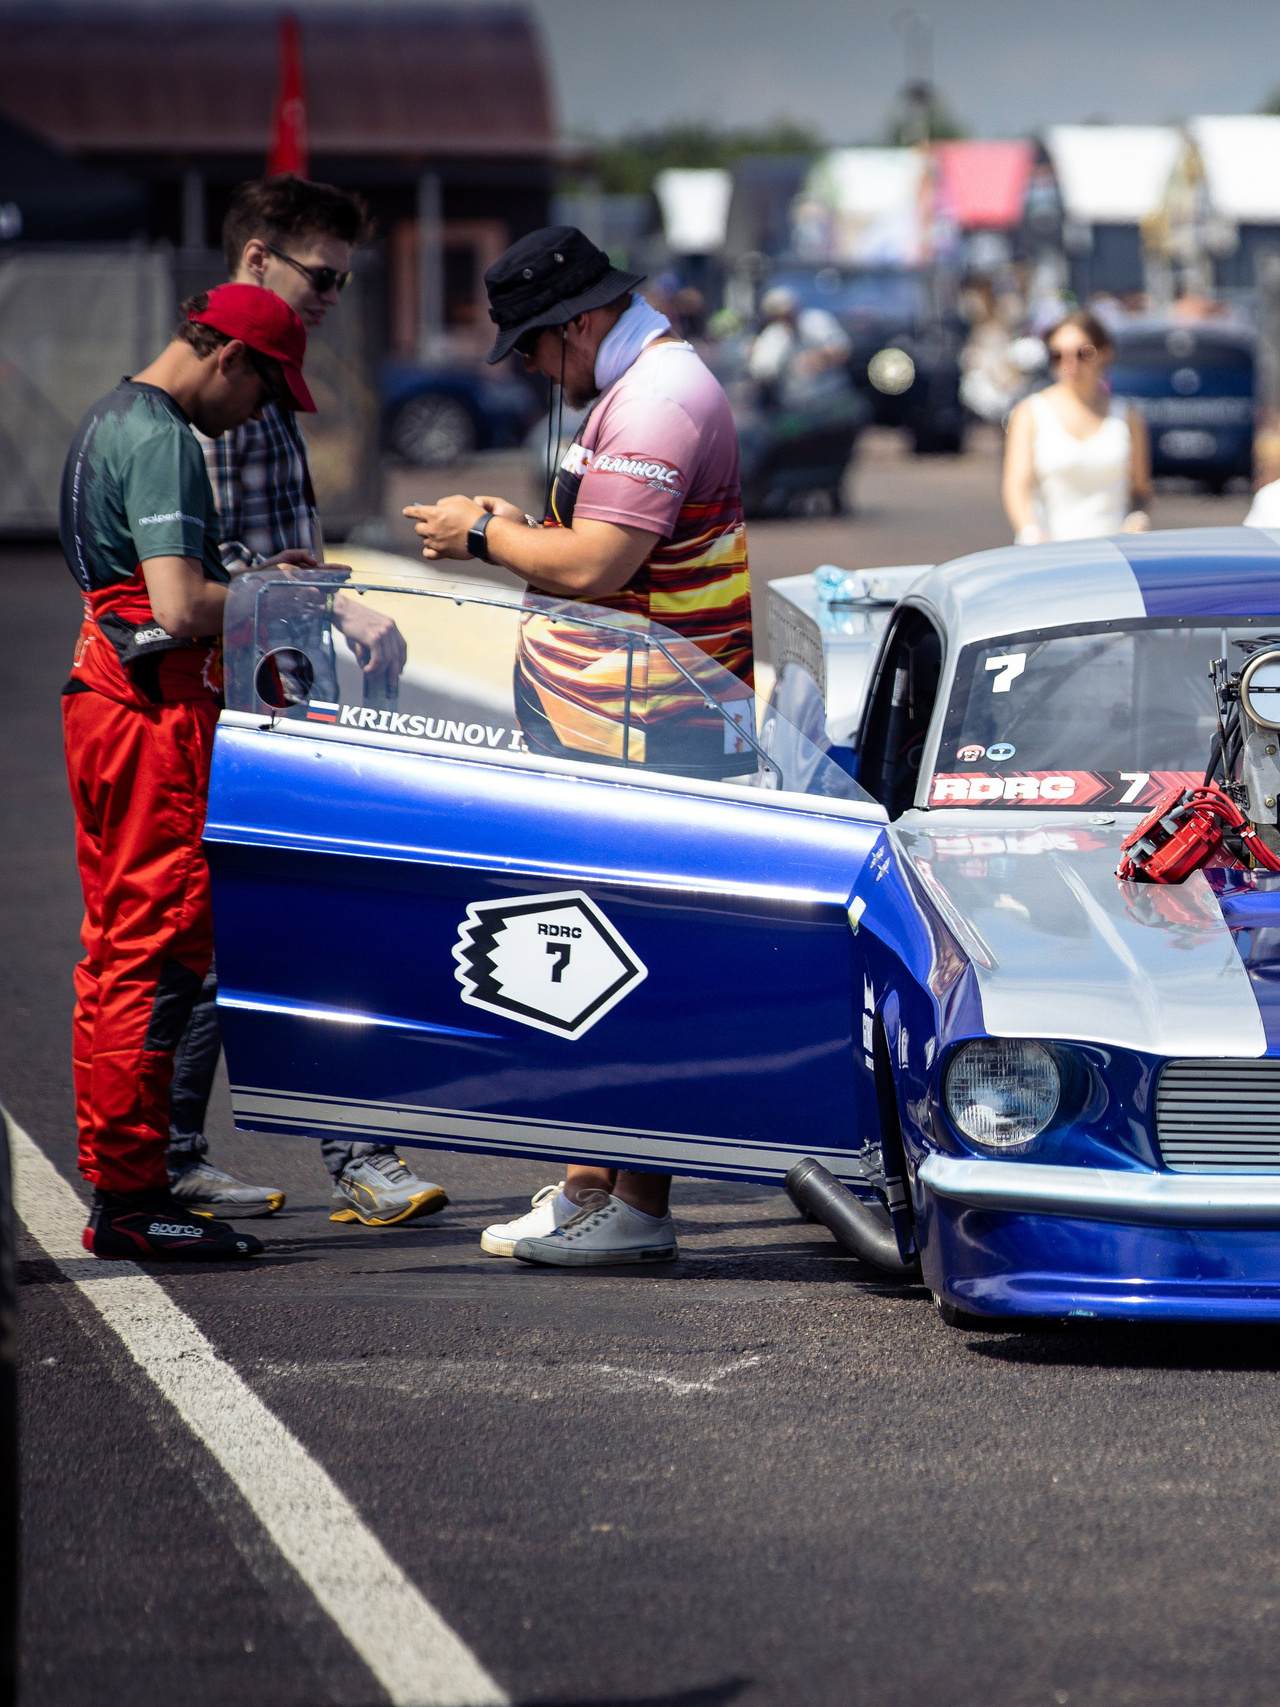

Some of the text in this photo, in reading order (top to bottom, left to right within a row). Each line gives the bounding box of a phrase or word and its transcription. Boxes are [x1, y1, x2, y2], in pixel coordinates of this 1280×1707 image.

[592, 454, 679, 484] FLAMHOLC
[646, 479, 683, 498] Racing
[984, 653, 1027, 693] 7
[339, 704, 529, 751] KRIKSUNOV I.
[932, 772, 1150, 804] RDRC 7
[537, 922, 582, 939] RDRC
[546, 941, 571, 983] 7
[148, 1222, 204, 1237] sparco
